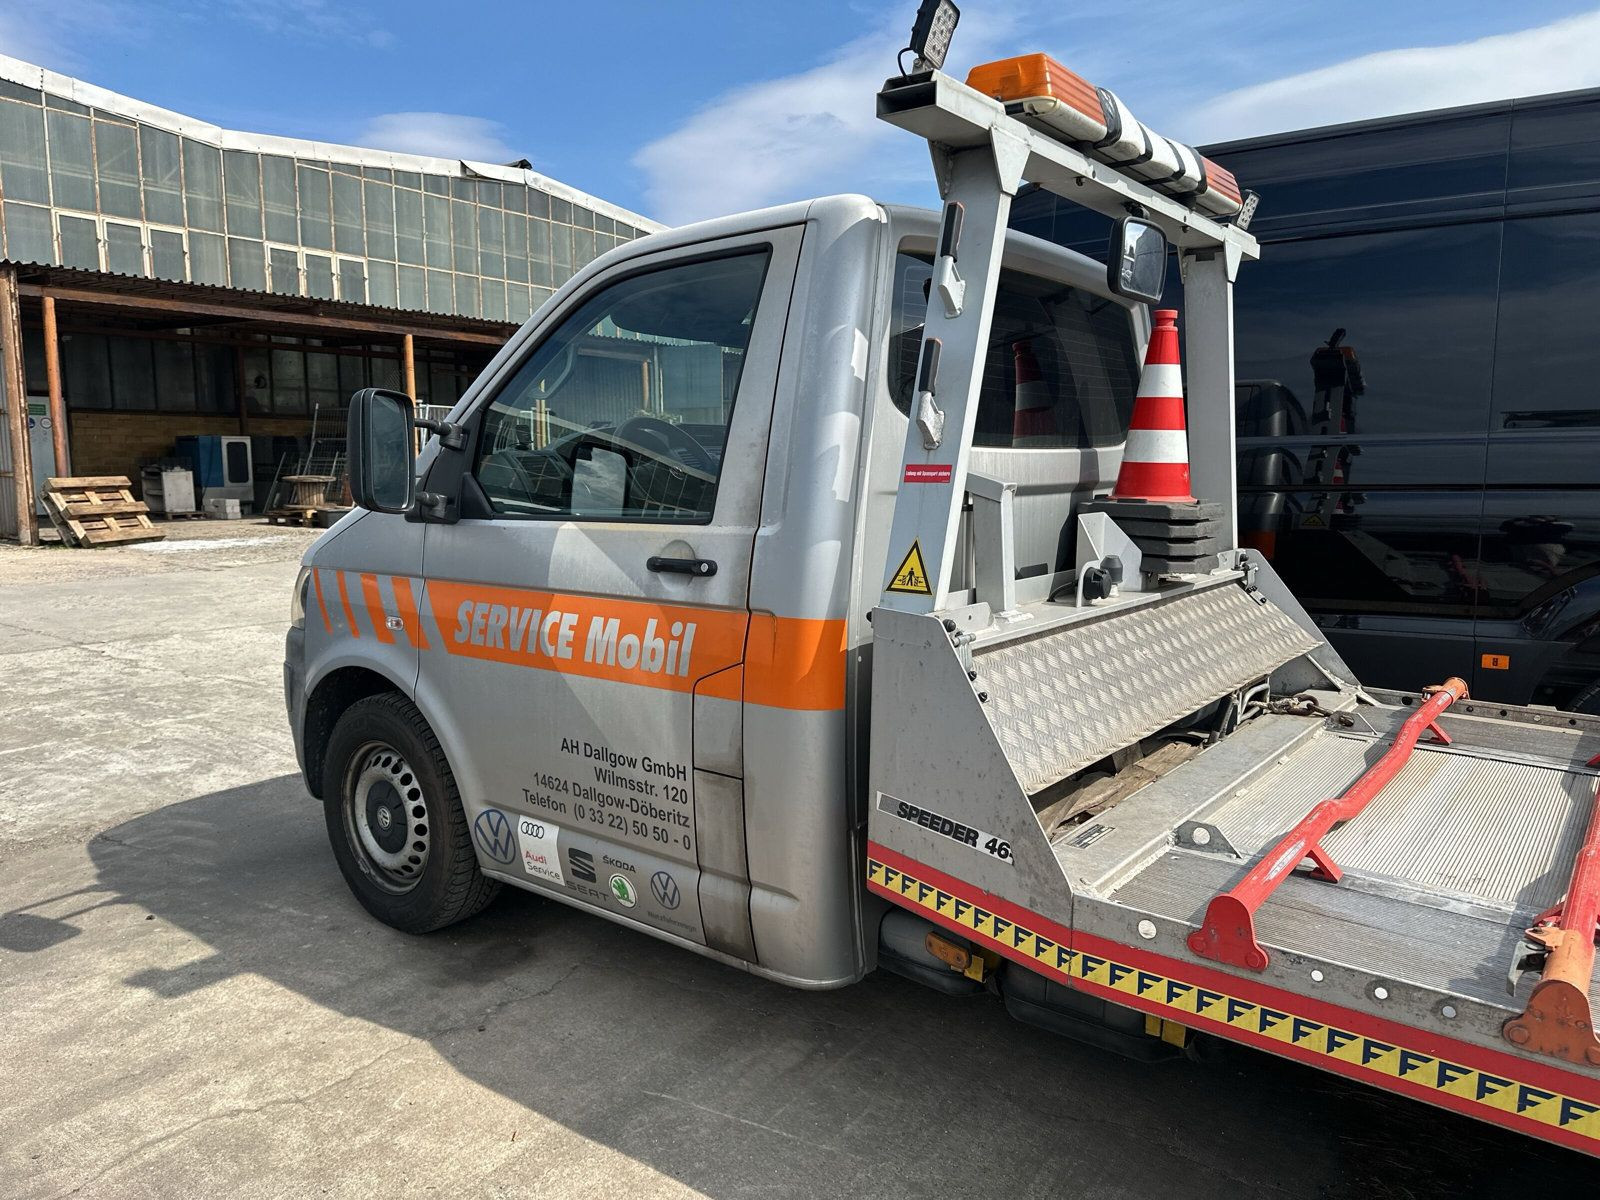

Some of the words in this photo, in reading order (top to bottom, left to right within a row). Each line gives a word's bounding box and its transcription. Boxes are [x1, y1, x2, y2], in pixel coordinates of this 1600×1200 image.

[454, 600, 579, 660] SERVICE
[584, 615, 697, 677] Mobil
[561, 738, 580, 756] AH
[584, 743, 637, 769] Dallgow
[642, 757, 687, 781] GmbH
[533, 772, 569, 793] 14624
[573, 783, 690, 828] Dallgow-Döberitz
[594, 767, 658, 797] Wilmsstr.
[663, 785, 688, 804] 120
[522, 789, 566, 814] Telefon
[574, 803, 585, 821] (0
[589, 808, 604, 824] 33
[608, 813, 628, 836] 22)
[632, 821, 648, 838] 50
[652, 827, 669, 844] 50
[683, 835, 691, 850] 0
[897, 801, 979, 848] SPEEDER
[984, 837, 1013, 860] 46
[525, 851, 547, 864] Audi
[526, 861, 560, 880] Service
[566, 881, 610, 901] SEAT
